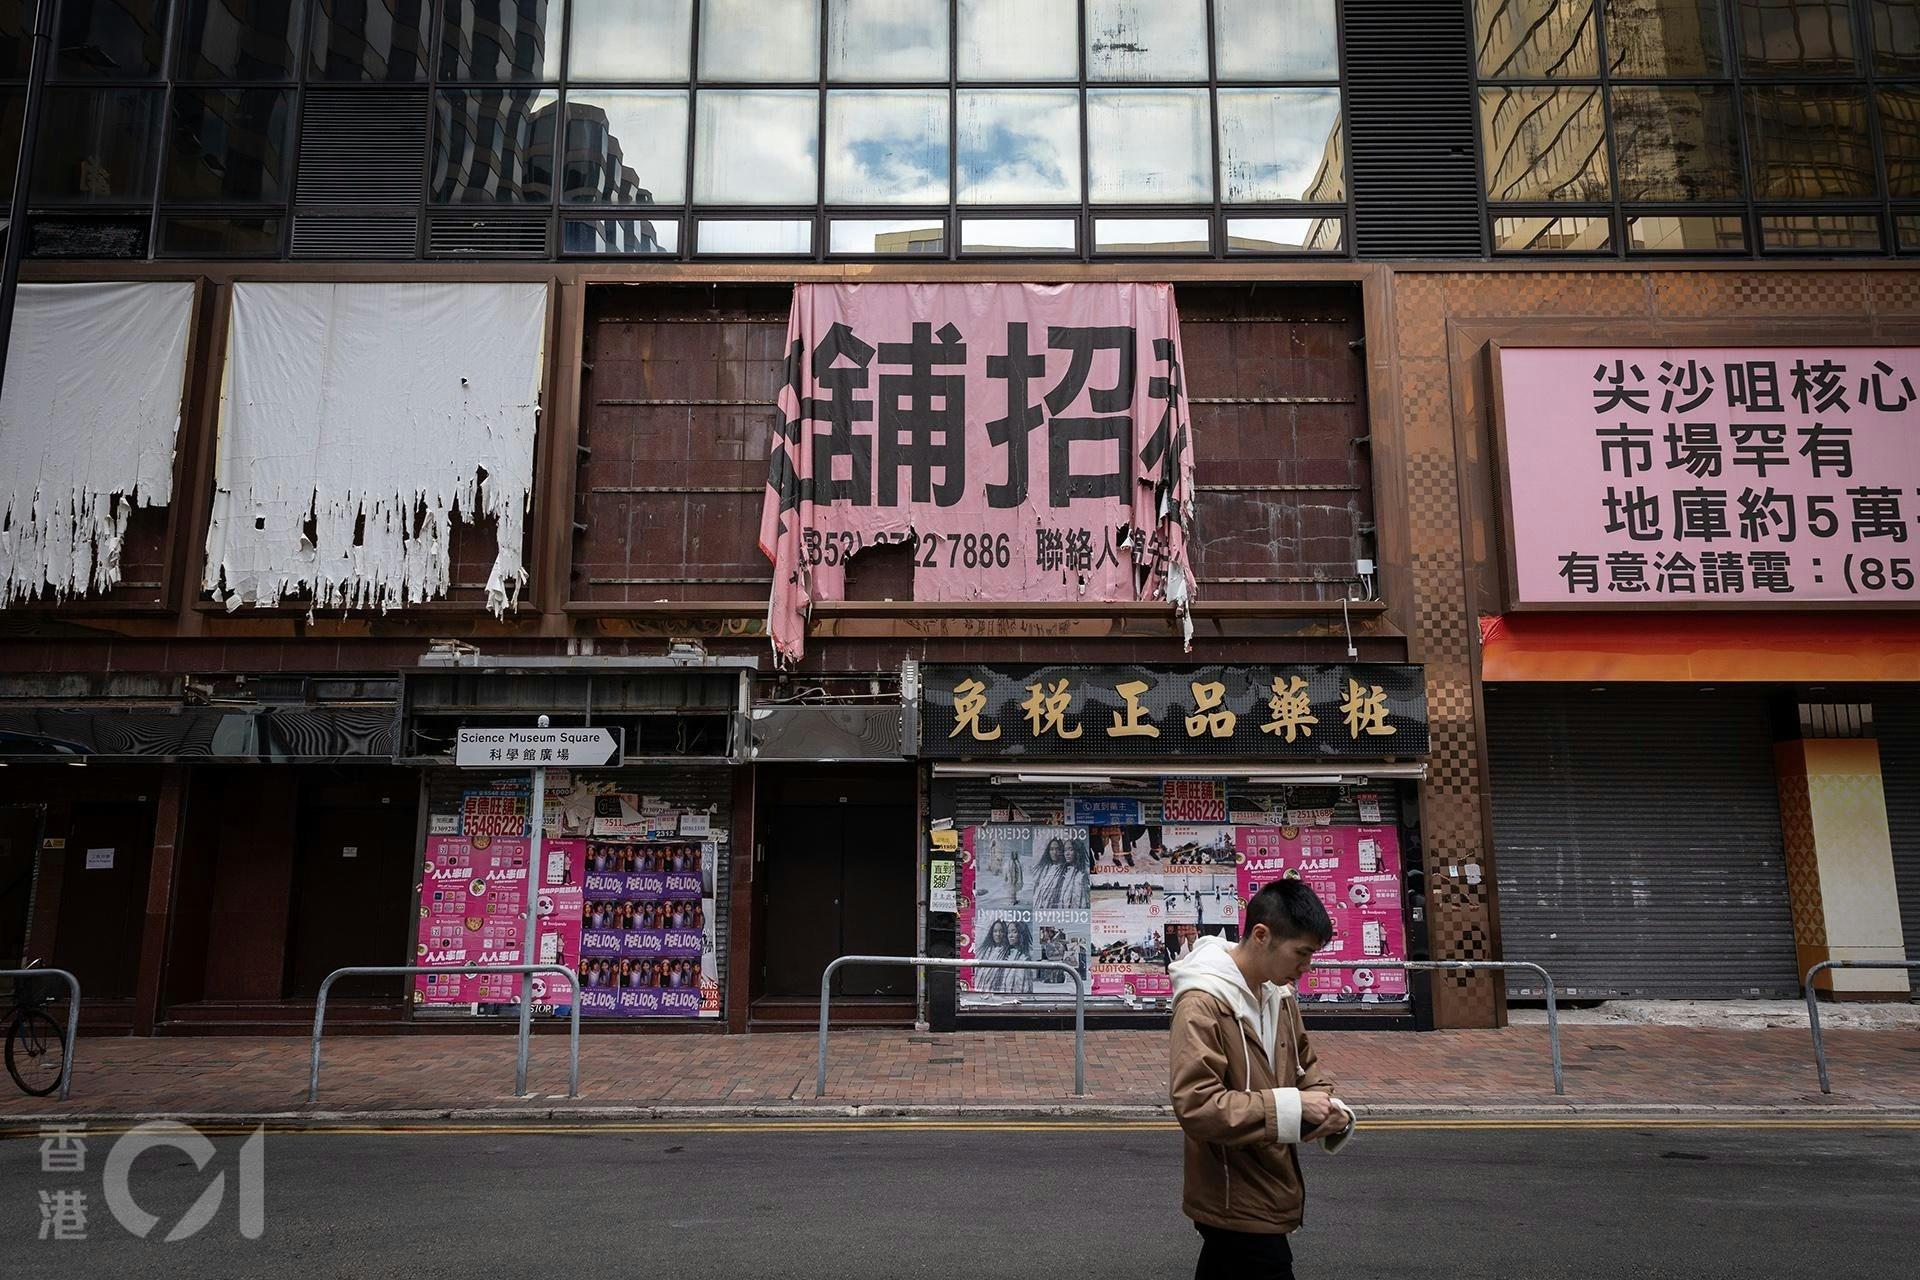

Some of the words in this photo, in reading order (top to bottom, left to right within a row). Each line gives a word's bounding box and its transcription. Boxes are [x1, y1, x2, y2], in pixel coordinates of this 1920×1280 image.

[1593, 359, 1917, 415] 尖沙咀核心
[1595, 422, 1855, 479] 市場罕有
[1601, 485, 1920, 544] 地庫約5萬
[947, 533, 1010, 569] 7886
[460, 732, 505, 743] Science
[510, 732, 556, 743] Museum
[560, 732, 600, 745] Square
[489, 748, 570, 761] 科學館廣場
[465, 798, 514, 815] 卓德旺舖
[1164, 800, 1224, 820] 55486228
[464, 816, 525, 836] 55486228
[977, 828, 1030, 840] BYREDO
[1034, 828, 1087, 840] BYREDO
[978, 910, 1030, 922] BYREDO
[1034, 910, 1088, 922] BYREDO
